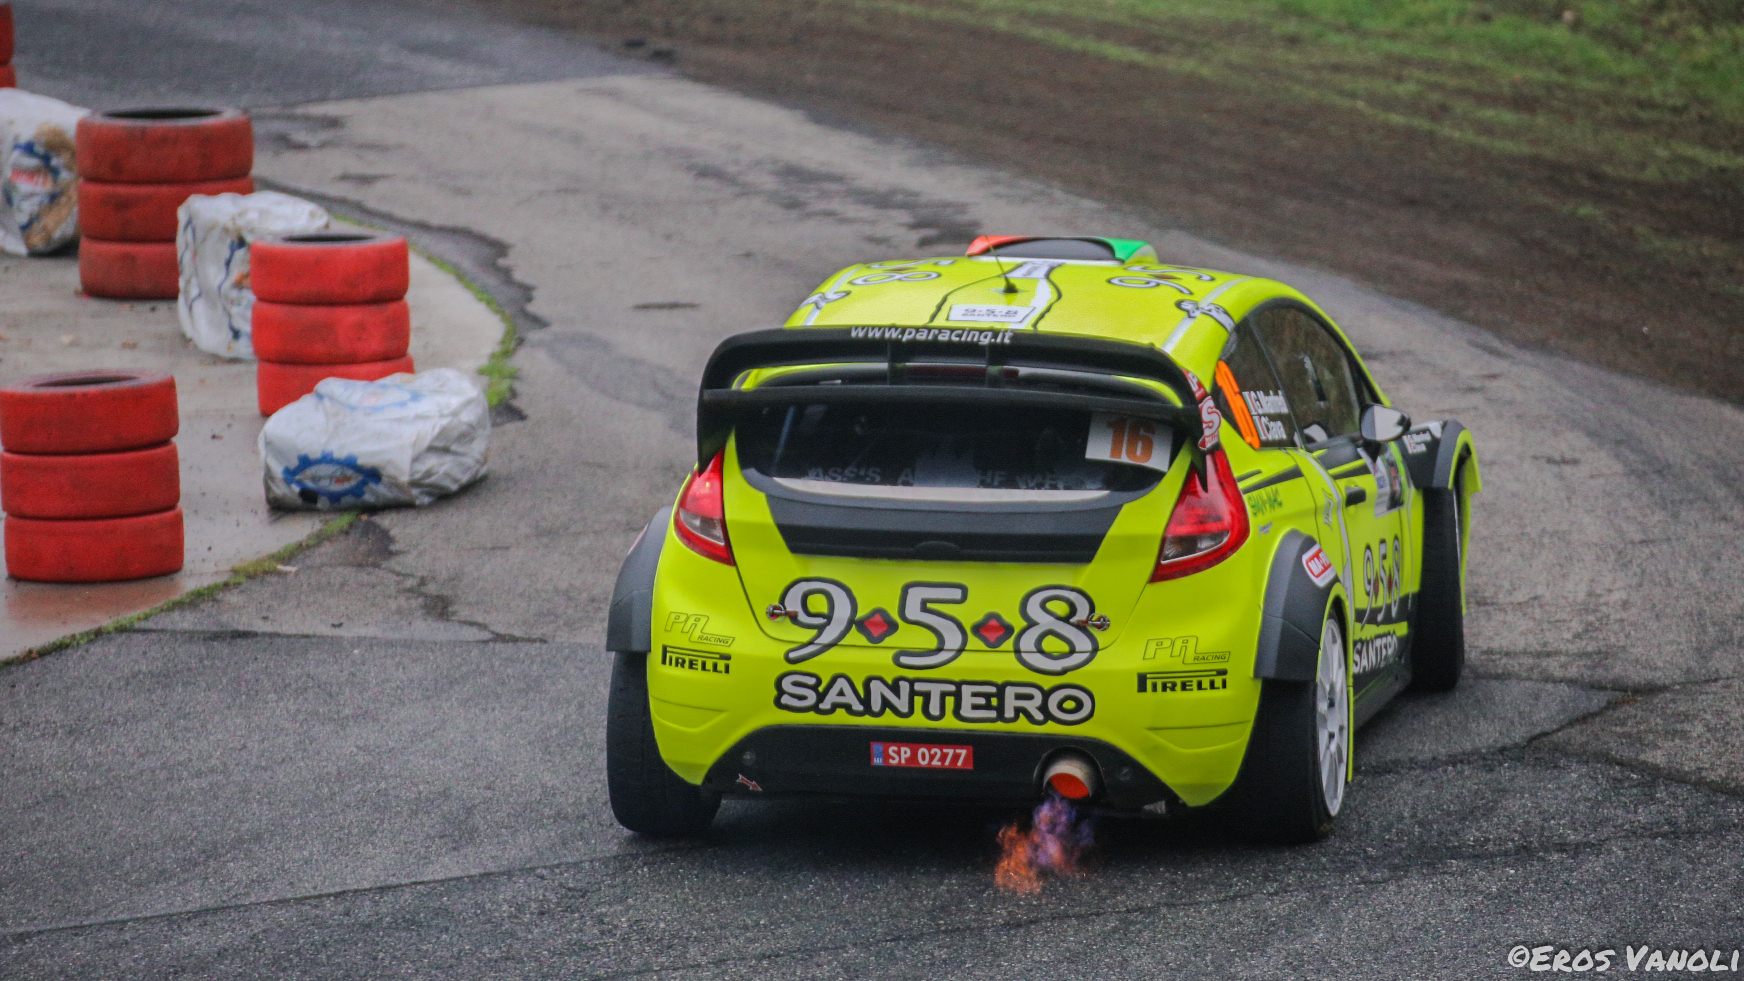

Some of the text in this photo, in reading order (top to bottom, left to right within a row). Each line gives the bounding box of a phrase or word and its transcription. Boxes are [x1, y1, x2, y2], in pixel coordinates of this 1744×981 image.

[850, 325, 1013, 346] www.paracing.it
[1106, 417, 1154, 464] 16
[697, 635, 730, 645] RACING
[660, 644, 732, 675] PIRELLI
[1192, 653, 1227, 662] RACING
[1136, 668, 1229, 693] PIRELLI
[773, 670, 1096, 726] SANTERO
[888, 746, 967, 766] SP 0277
